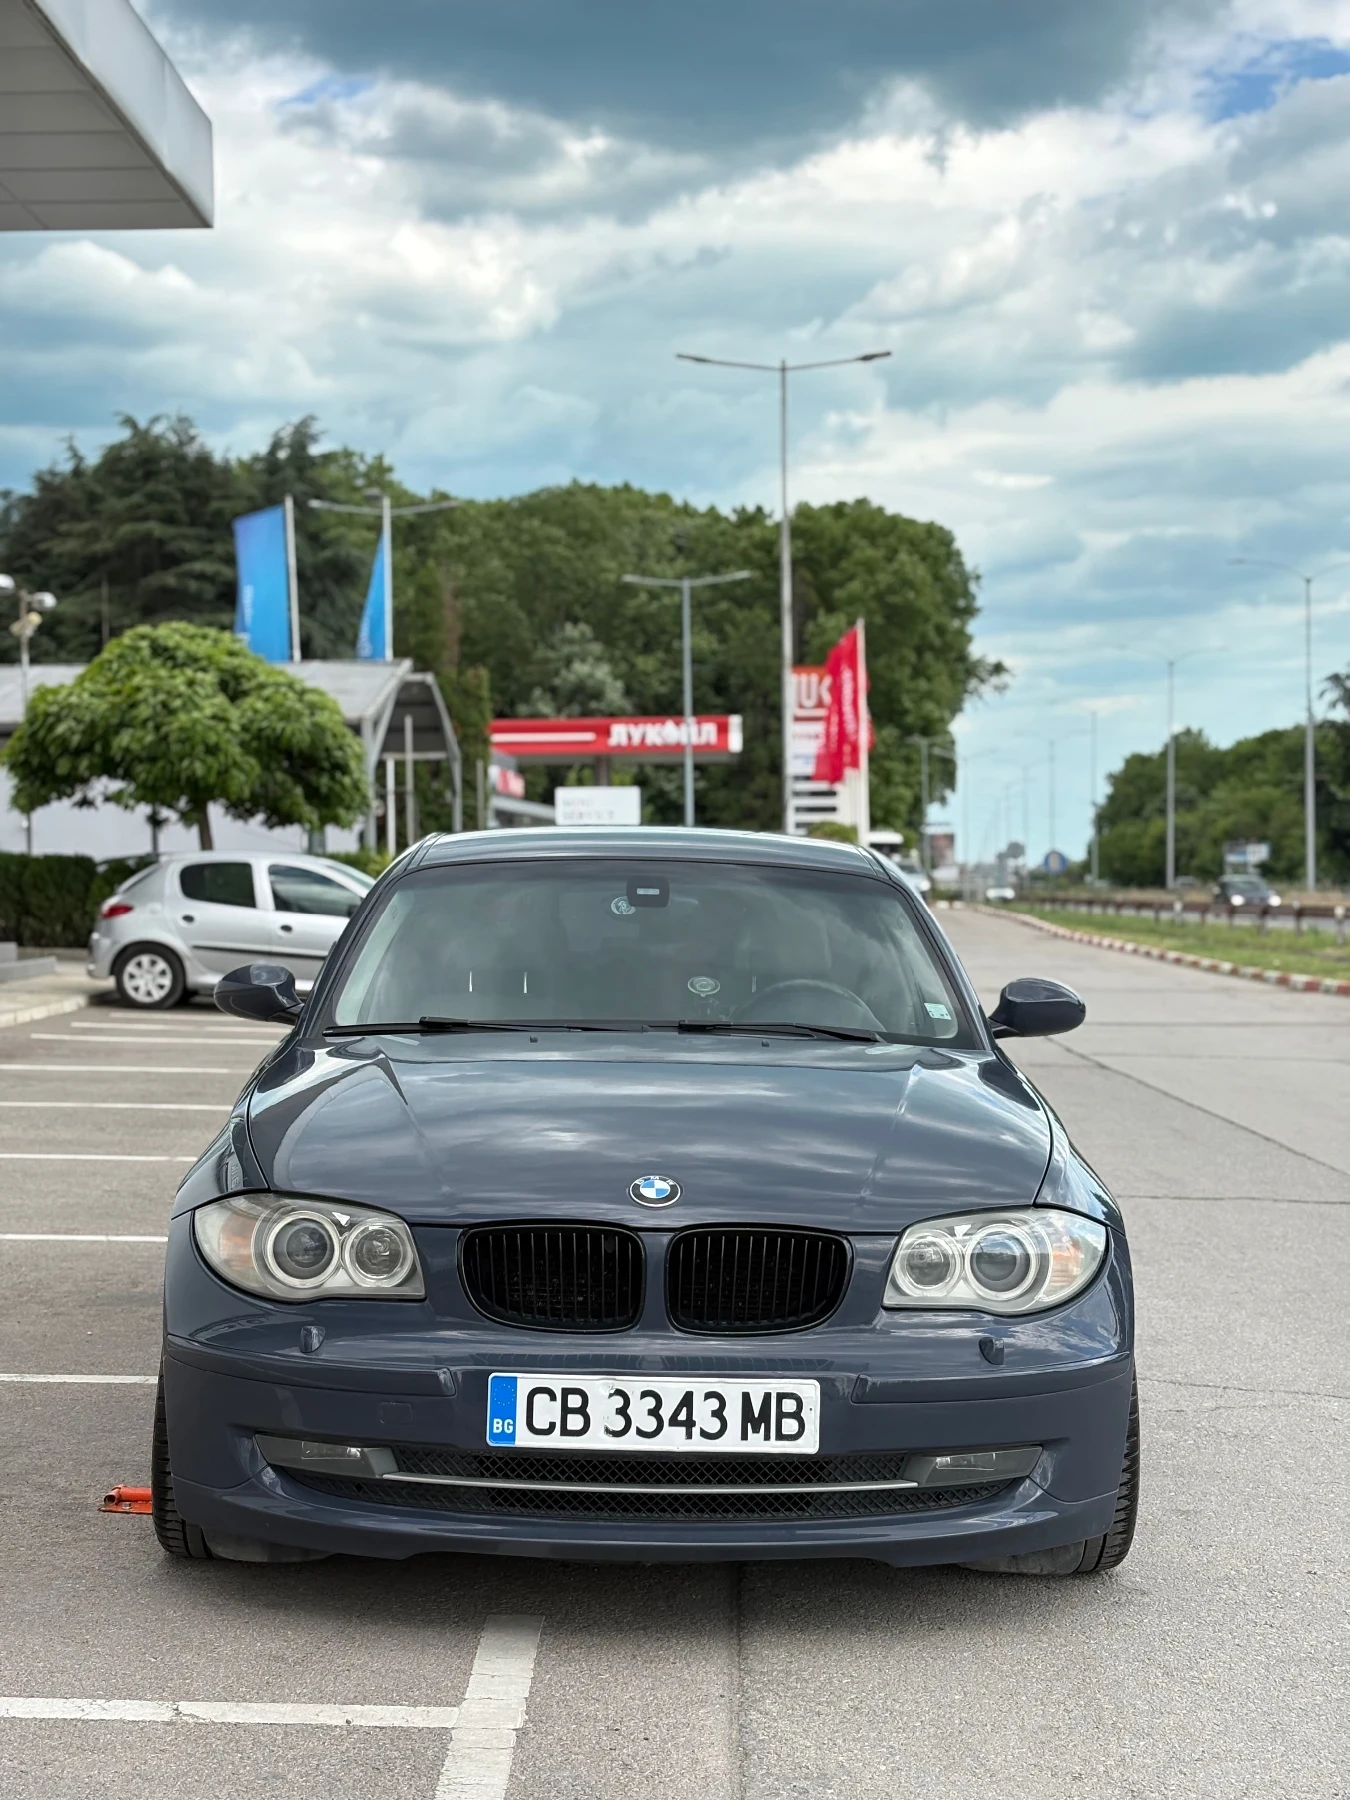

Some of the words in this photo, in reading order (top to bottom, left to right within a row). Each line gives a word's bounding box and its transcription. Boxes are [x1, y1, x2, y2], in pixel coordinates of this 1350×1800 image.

[492, 1418, 514, 1434] BG
[526, 1386, 590, 1437] CB
[604, 1387, 728, 1441] 3343
[740, 1391, 805, 1442] MB
